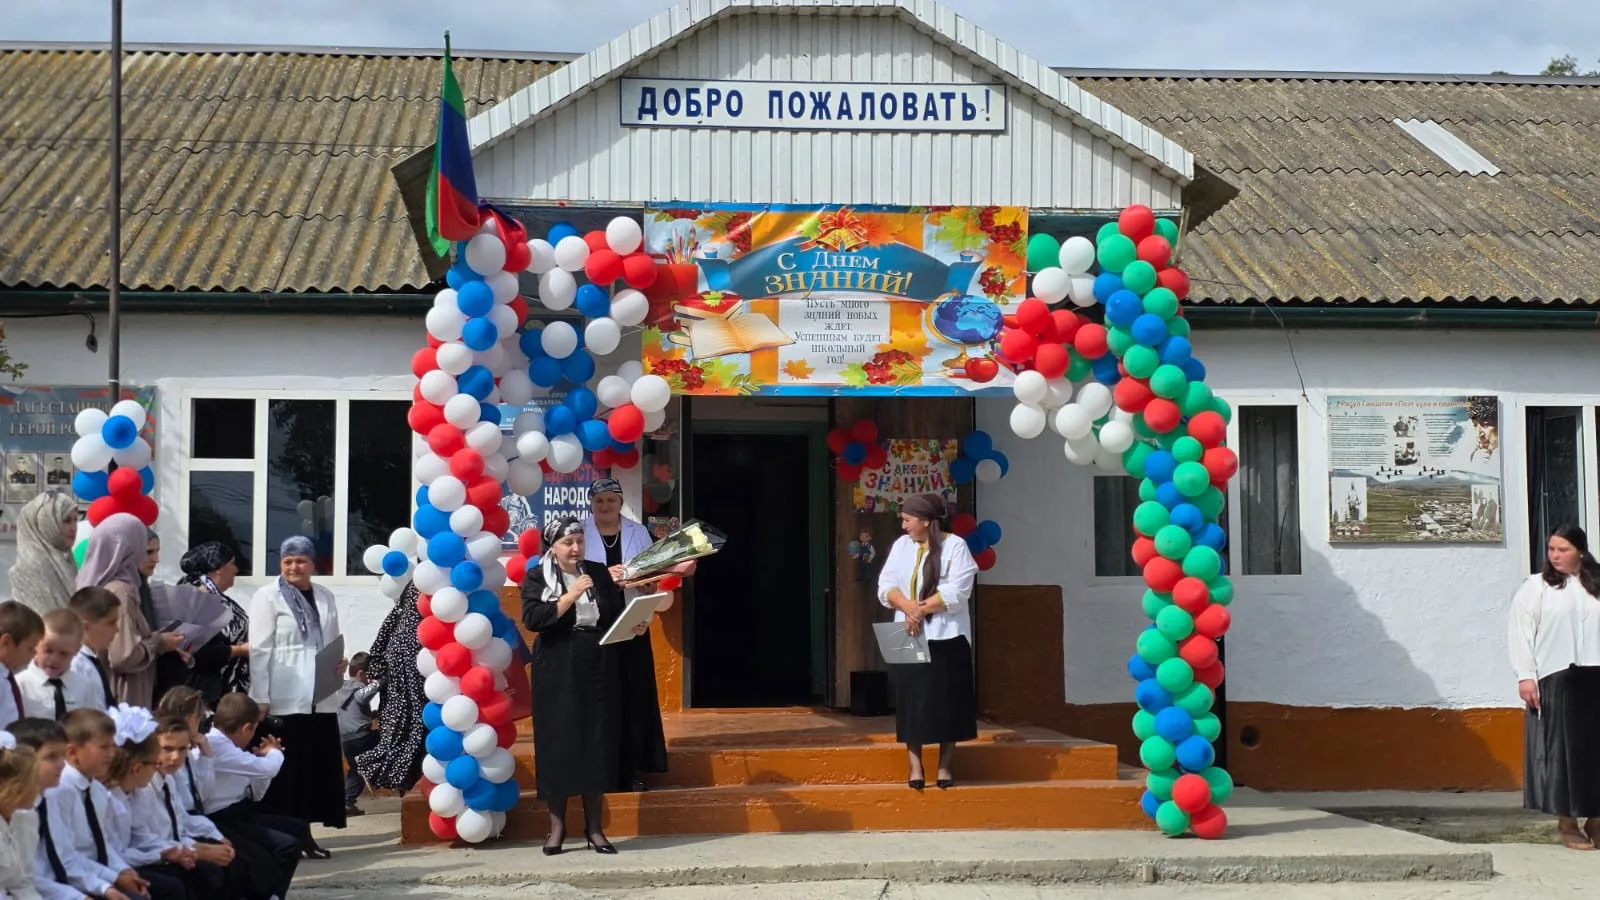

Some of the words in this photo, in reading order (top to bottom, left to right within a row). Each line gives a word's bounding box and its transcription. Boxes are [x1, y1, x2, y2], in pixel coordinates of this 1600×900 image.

[637, 87, 744, 121] ДОБРО
[768, 88, 991, 122] ПОЖАЛОВАТЬ!
[777, 252, 797, 270] С
[764, 270, 913, 298] ЗНАНИЙ!
[544, 486, 591, 508] НАРОДО
